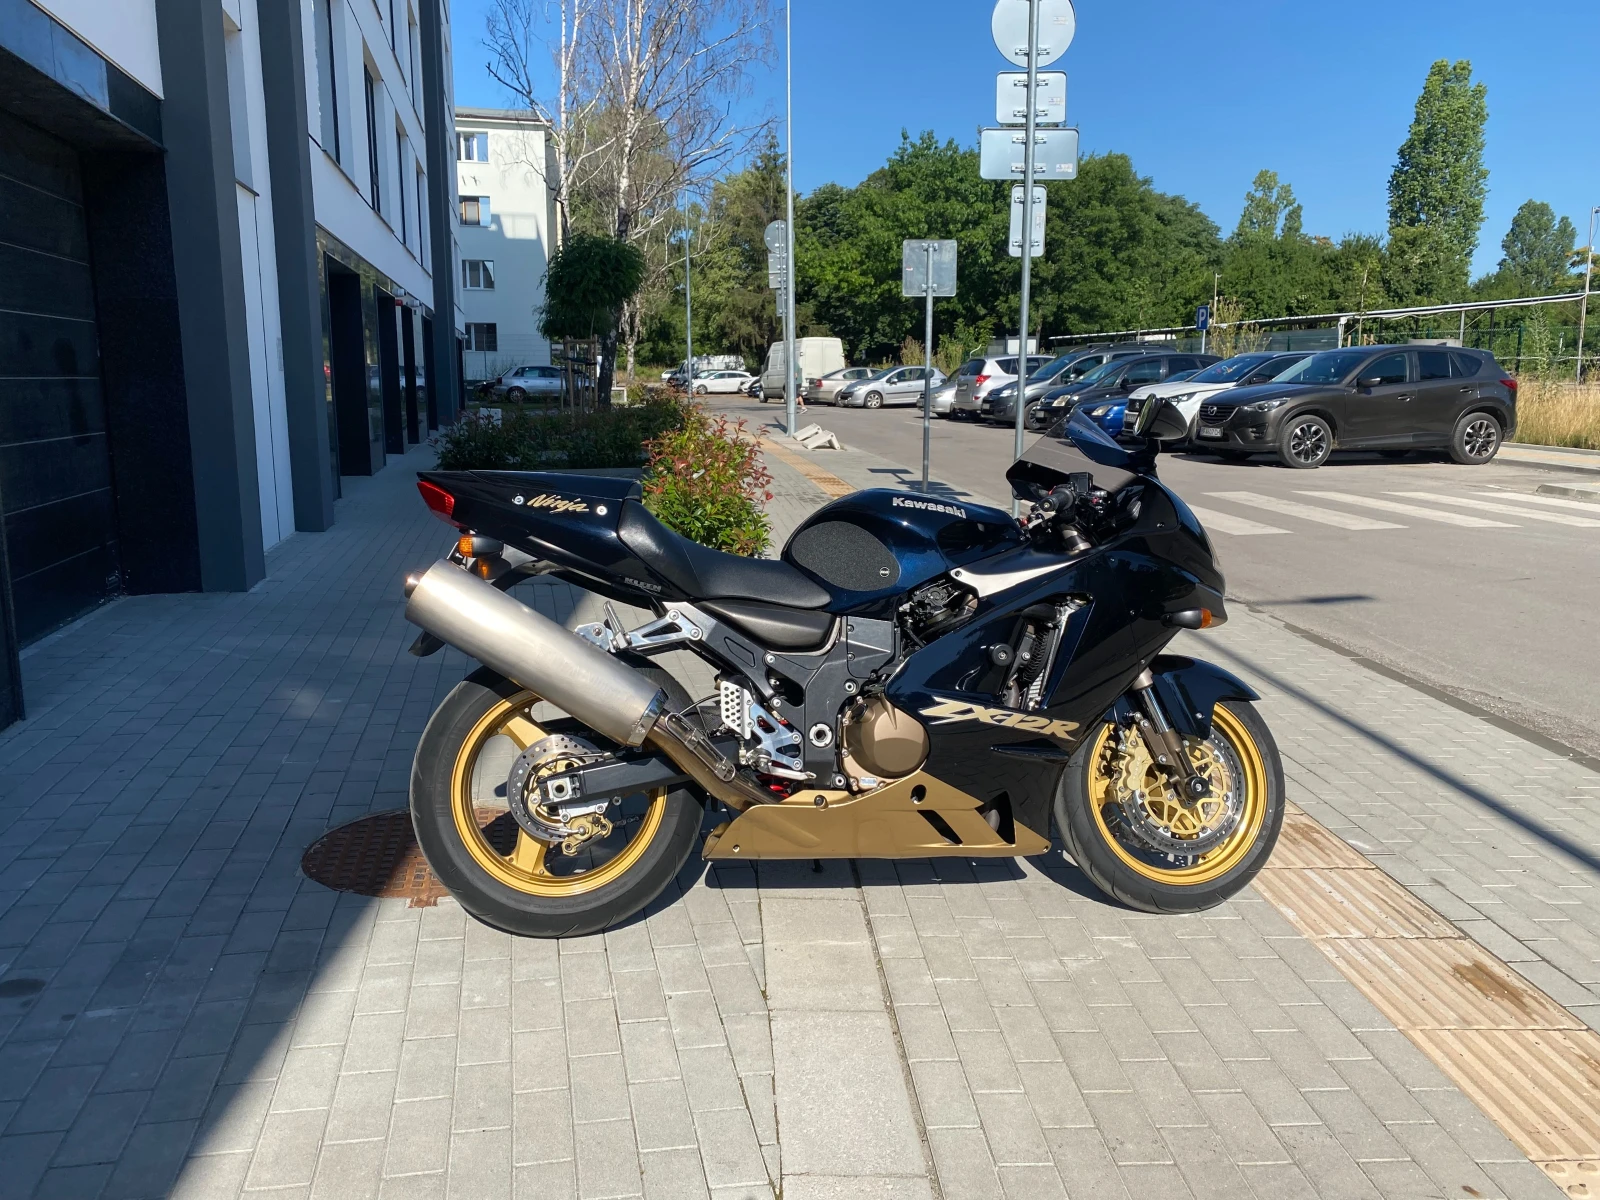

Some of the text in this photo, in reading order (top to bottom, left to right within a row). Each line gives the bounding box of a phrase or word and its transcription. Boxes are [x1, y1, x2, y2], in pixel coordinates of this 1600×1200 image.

[1198, 308, 1207, 328] P
[526, 494, 590, 514] Ninja
[892, 497, 967, 519] Kawasaki
